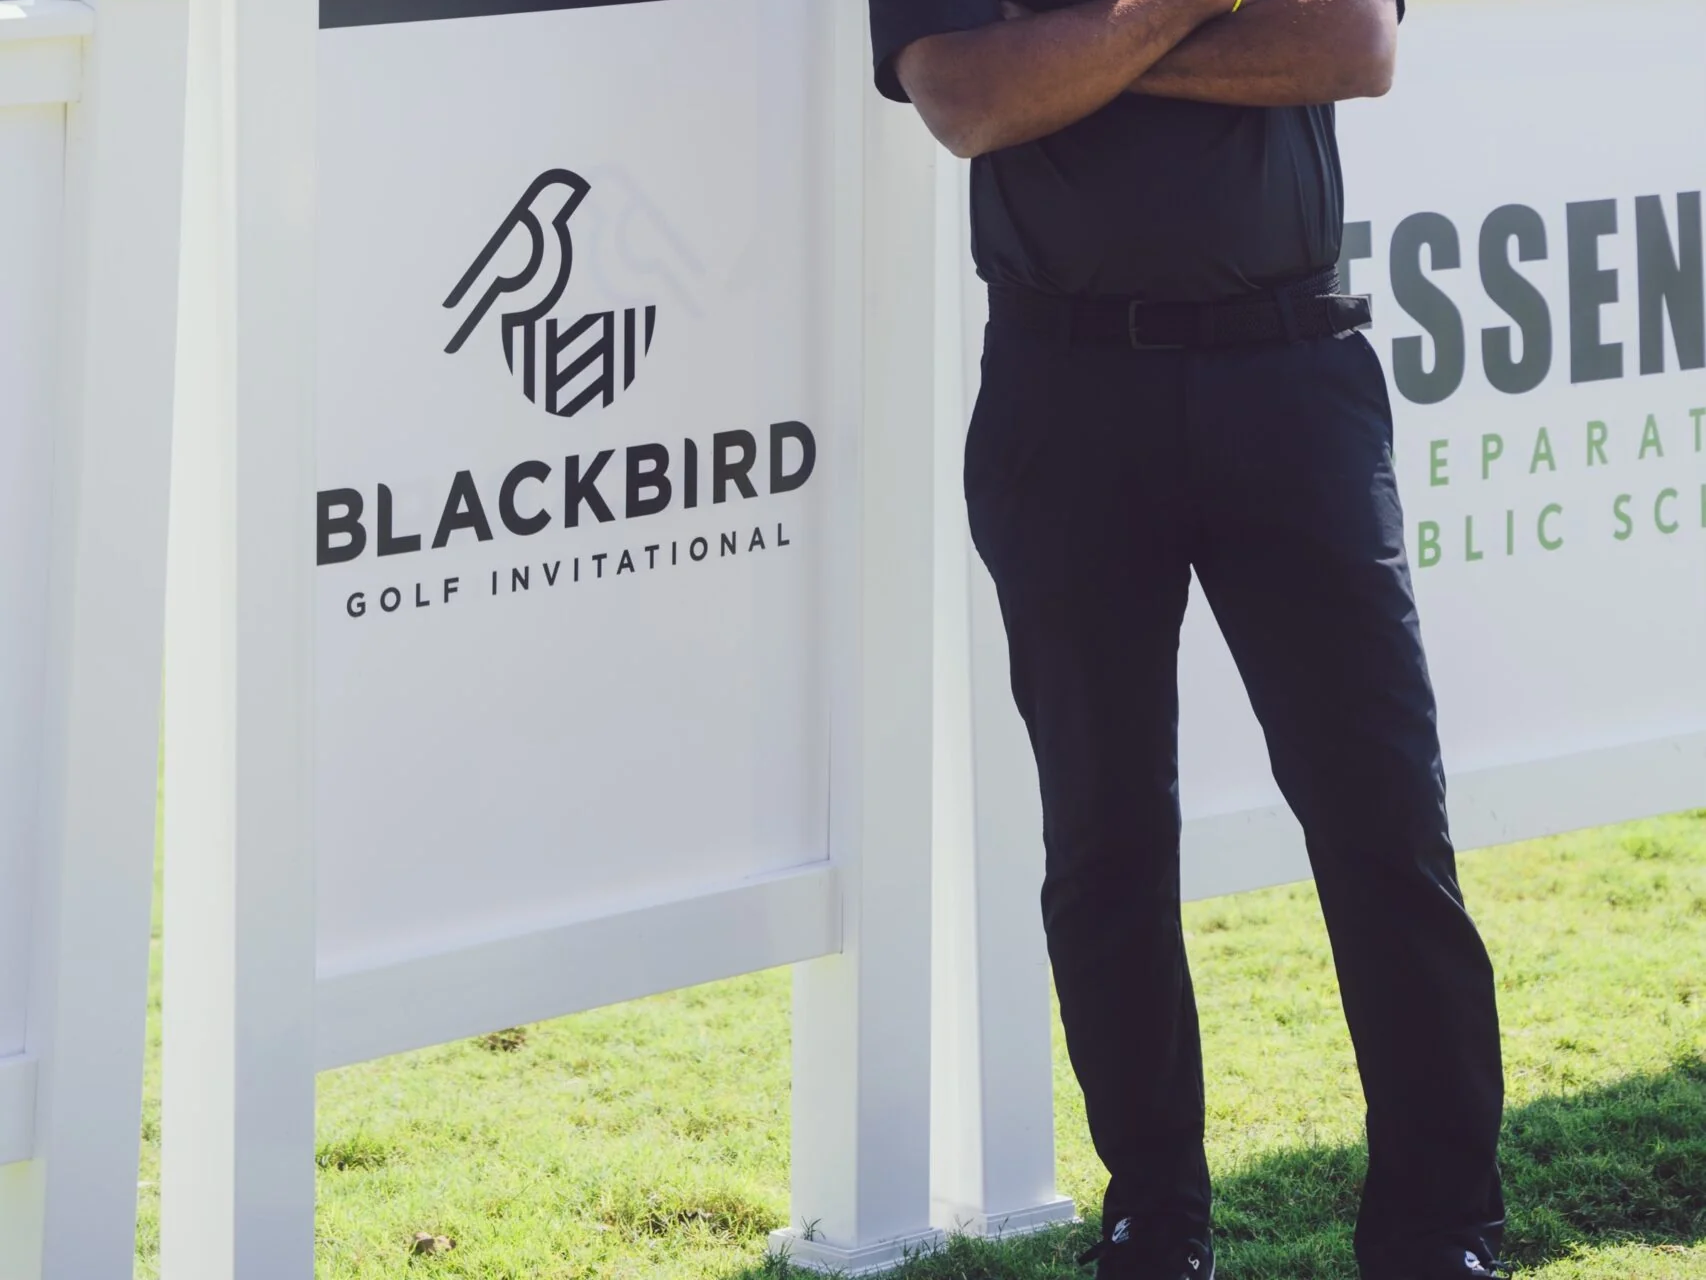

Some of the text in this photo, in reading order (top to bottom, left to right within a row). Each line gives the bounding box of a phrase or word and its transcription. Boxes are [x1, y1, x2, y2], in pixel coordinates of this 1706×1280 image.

[1340, 190, 1706, 405] SSEN
[316, 420, 816, 566] BLACKBIRD
[1391, 407, 1706, 487] EPARAT
[1613, 484, 1706, 541] SC
[346, 523, 790, 618] GOLF INVITATIONAL
